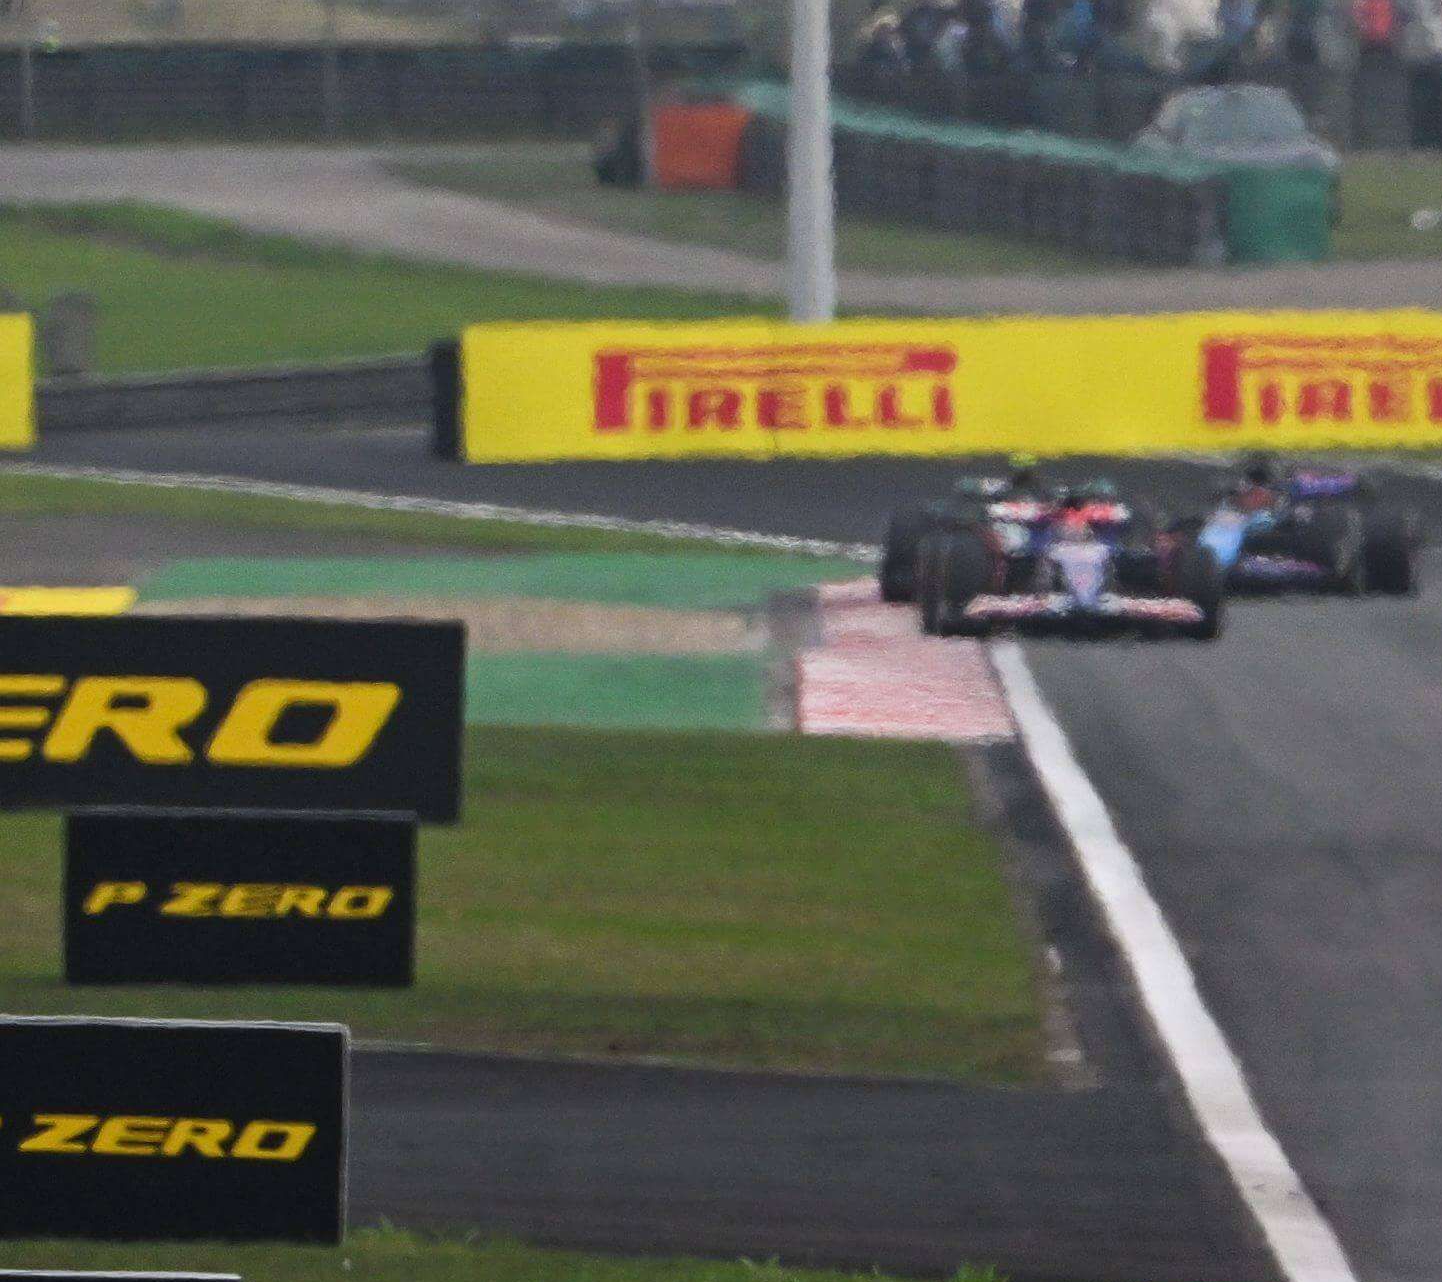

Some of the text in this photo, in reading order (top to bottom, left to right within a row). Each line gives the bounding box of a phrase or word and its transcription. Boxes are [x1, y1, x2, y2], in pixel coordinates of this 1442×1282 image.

[594, 342, 957, 431] PIRELLI
[85, 881, 393, 919] P ZERO
[19, 1113, 316, 1161] ZERO
